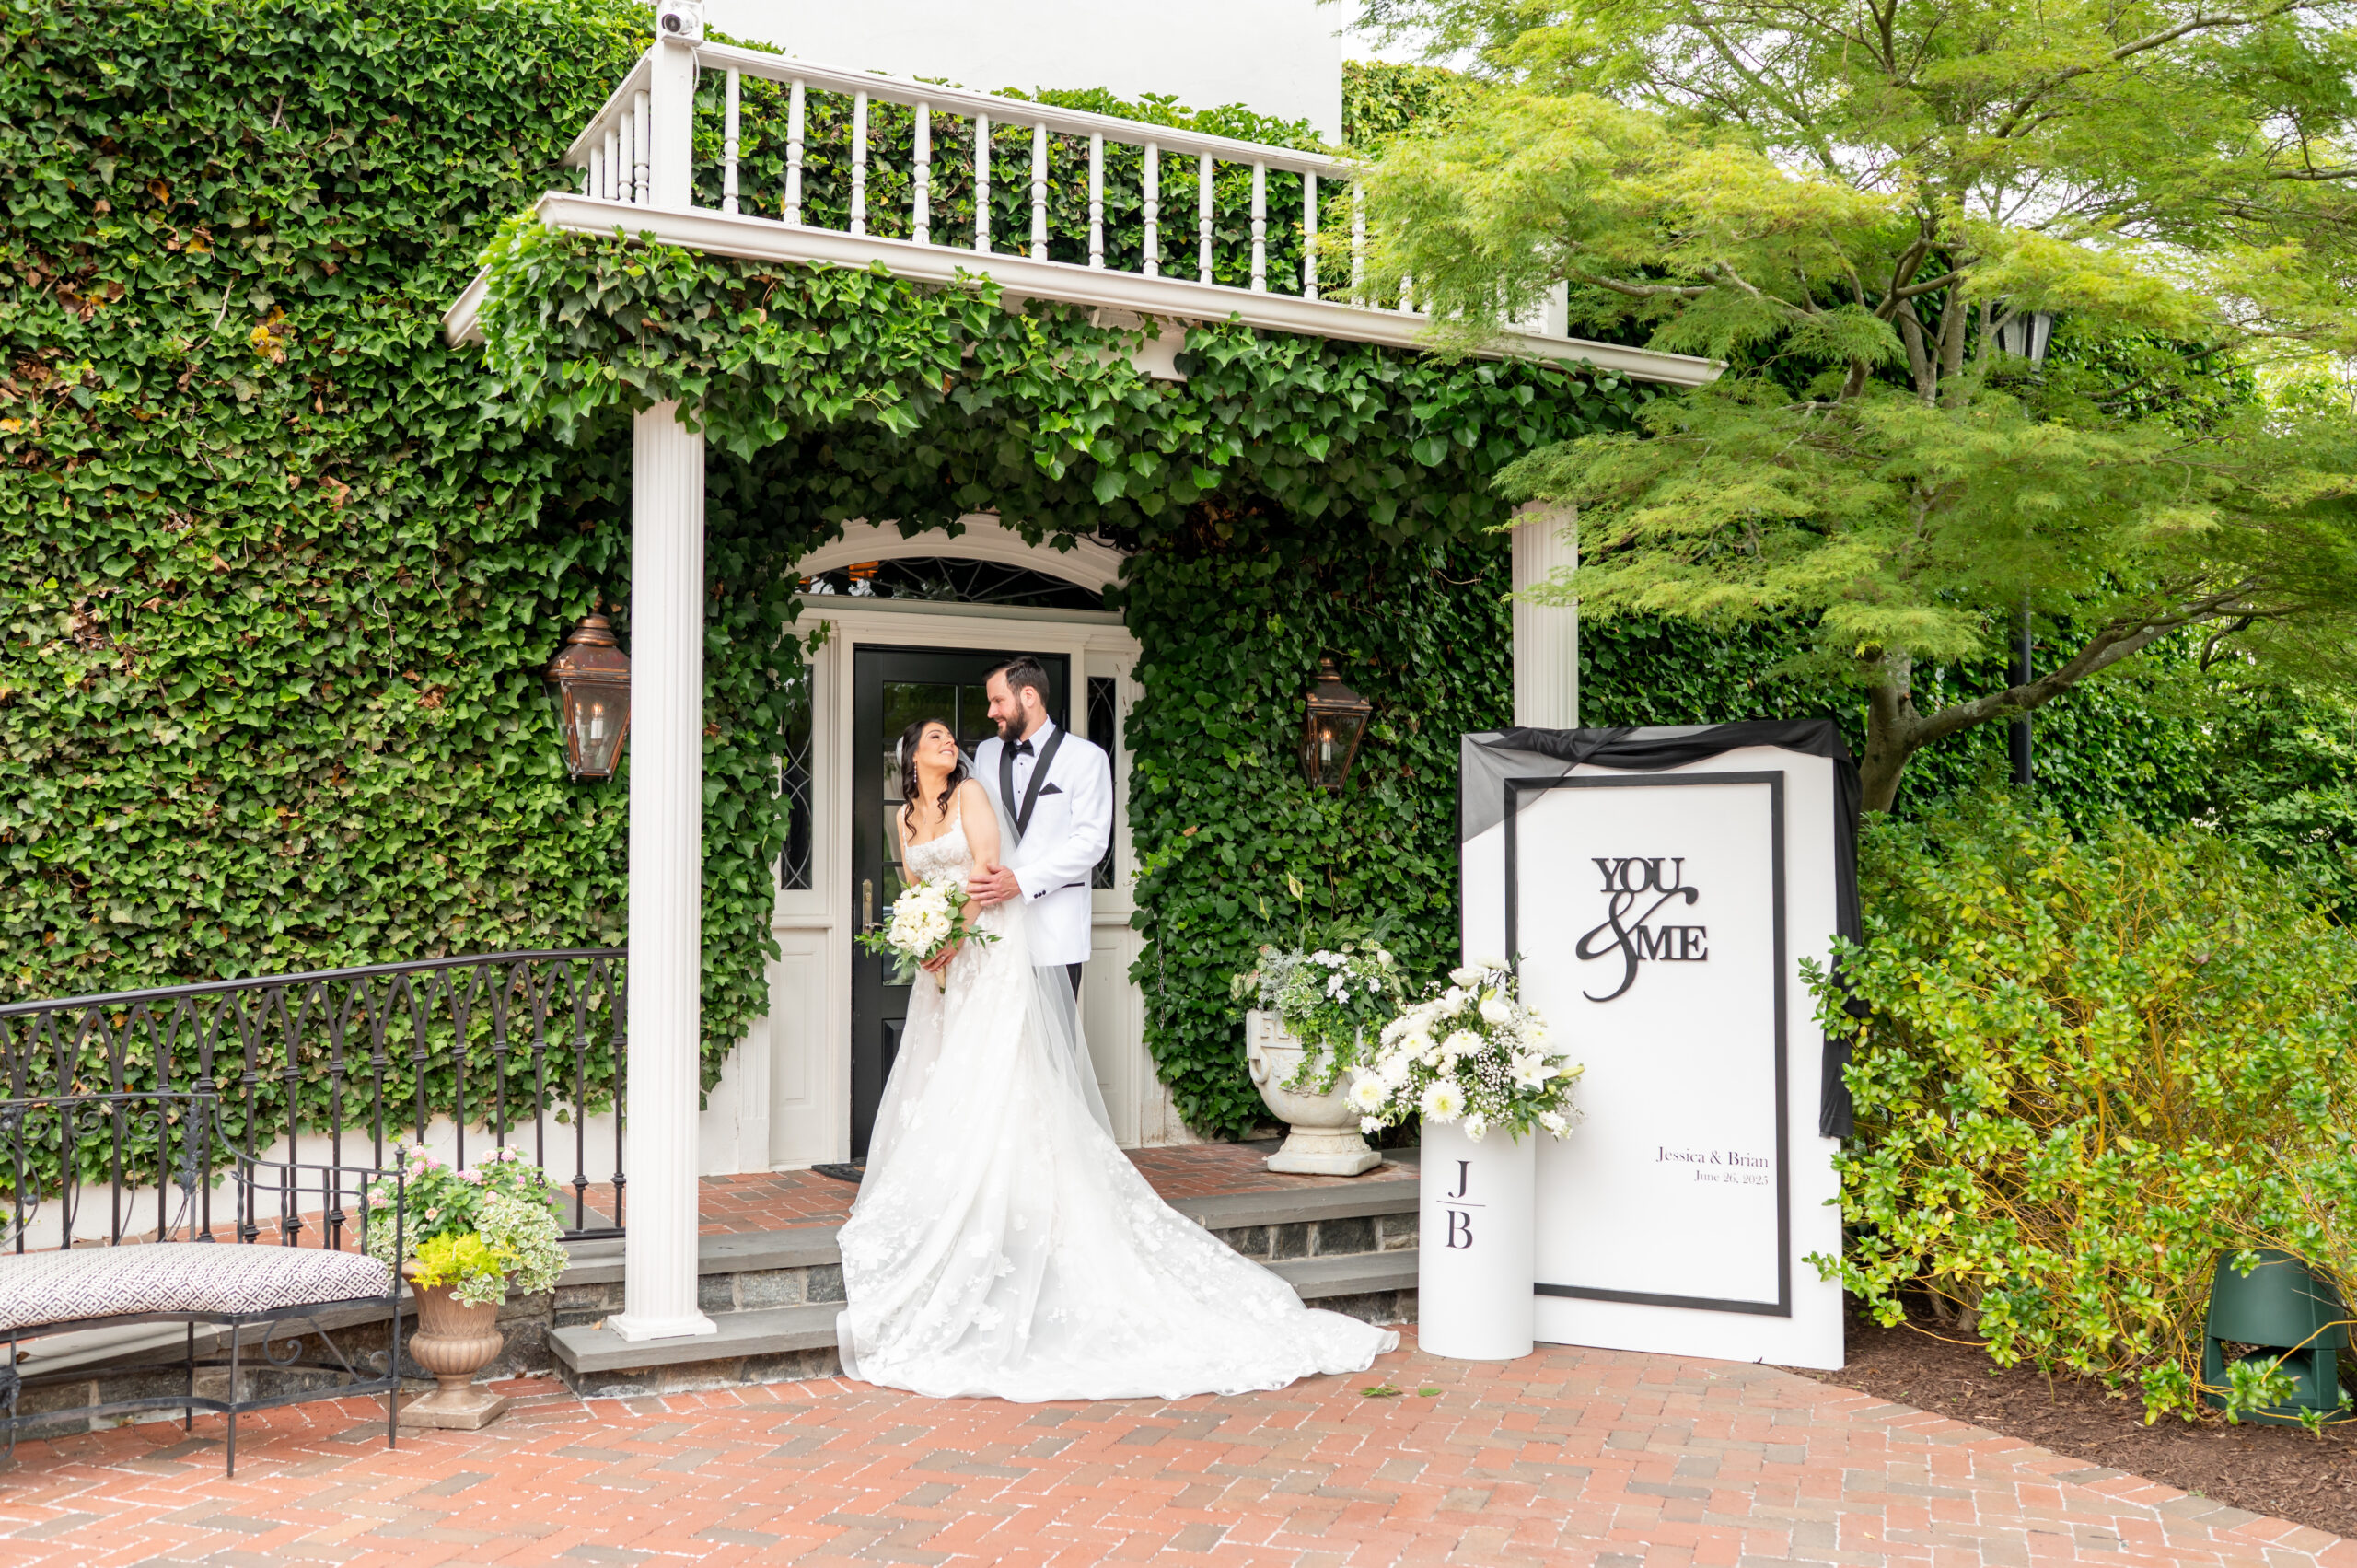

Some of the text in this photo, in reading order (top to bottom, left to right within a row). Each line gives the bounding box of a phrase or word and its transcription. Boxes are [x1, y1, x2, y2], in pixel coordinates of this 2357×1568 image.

[1591, 857, 1685, 893] YOU
[1576, 886, 1708, 1002] & ME
[1655, 1146, 1769, 1167] Jessica & Brian
[1447, 1159, 1473, 1199] J
[1694, 1169, 1719, 1182] June
[1743, 1173, 1769, 1186] 2025
[1445, 1209, 1473, 1249] B
